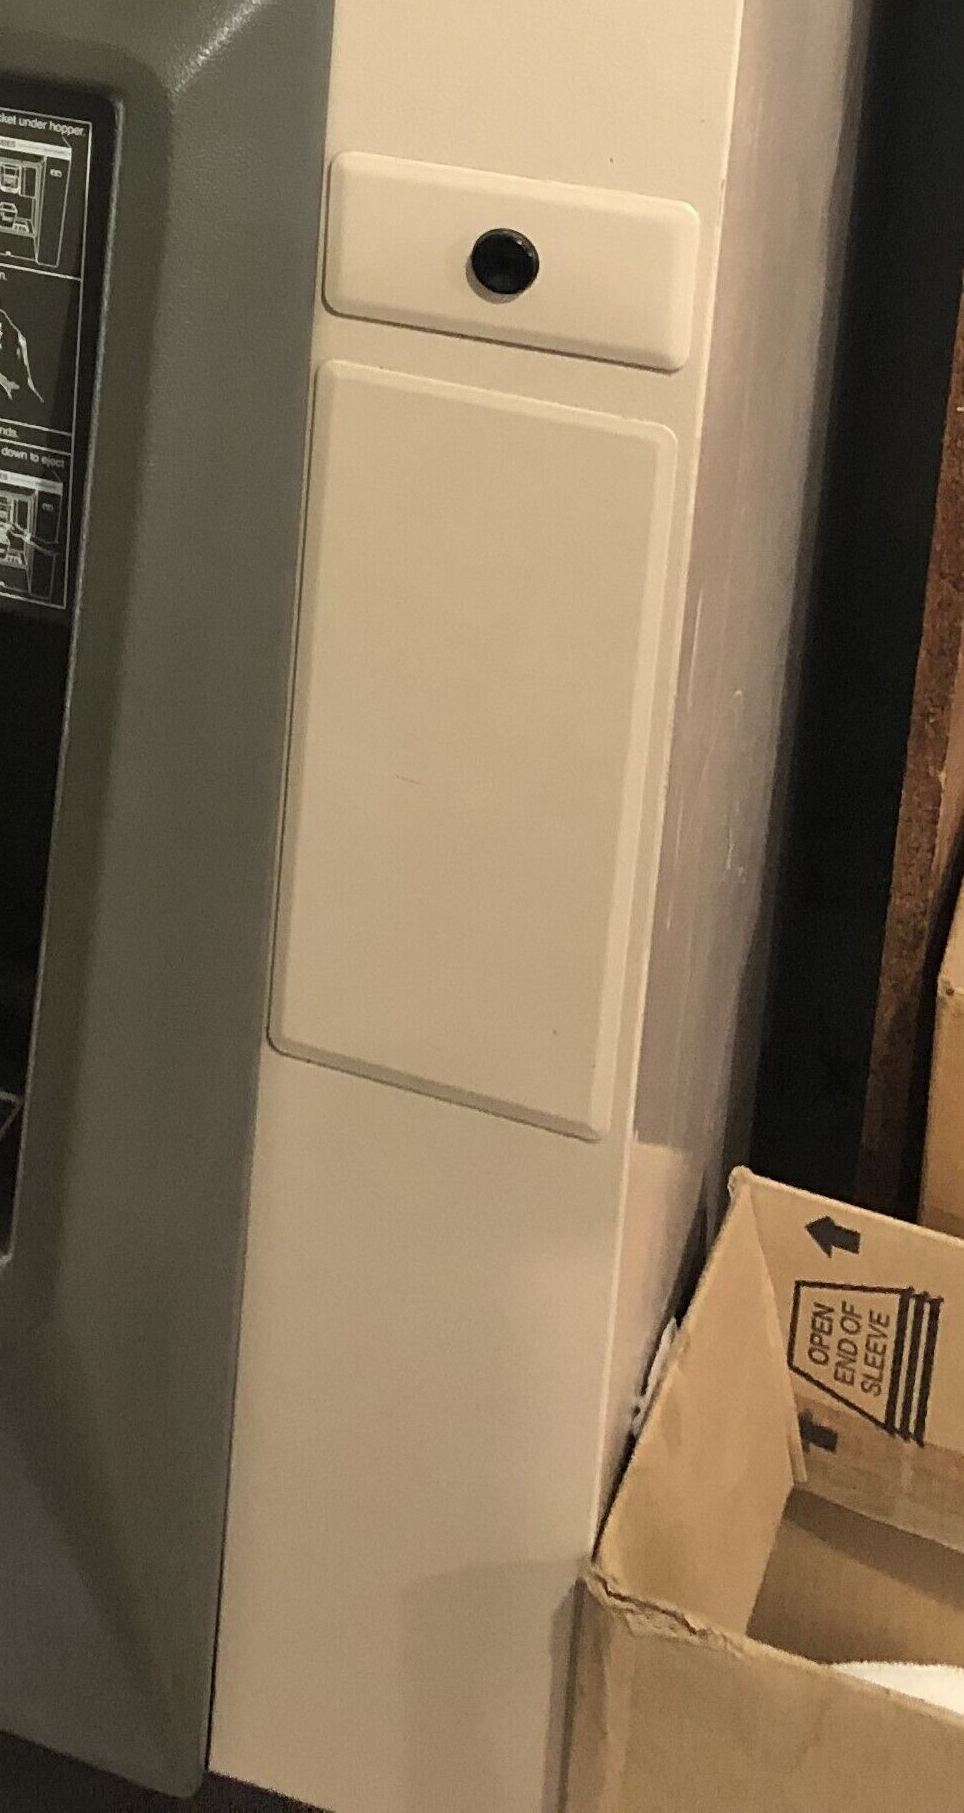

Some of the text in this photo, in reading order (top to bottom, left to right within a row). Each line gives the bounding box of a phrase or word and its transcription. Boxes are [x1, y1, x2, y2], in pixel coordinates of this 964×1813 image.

[19, 117, 47, 130] under
[1, 447, 28, 460] down
[29, 452, 40, 462] to
[41, 455, 65, 468] eject
[807, 1301, 835, 1366] OPEN
[833, 1300, 863, 1386] END OF
[860, 1309, 890, 1397] SLEEVE
